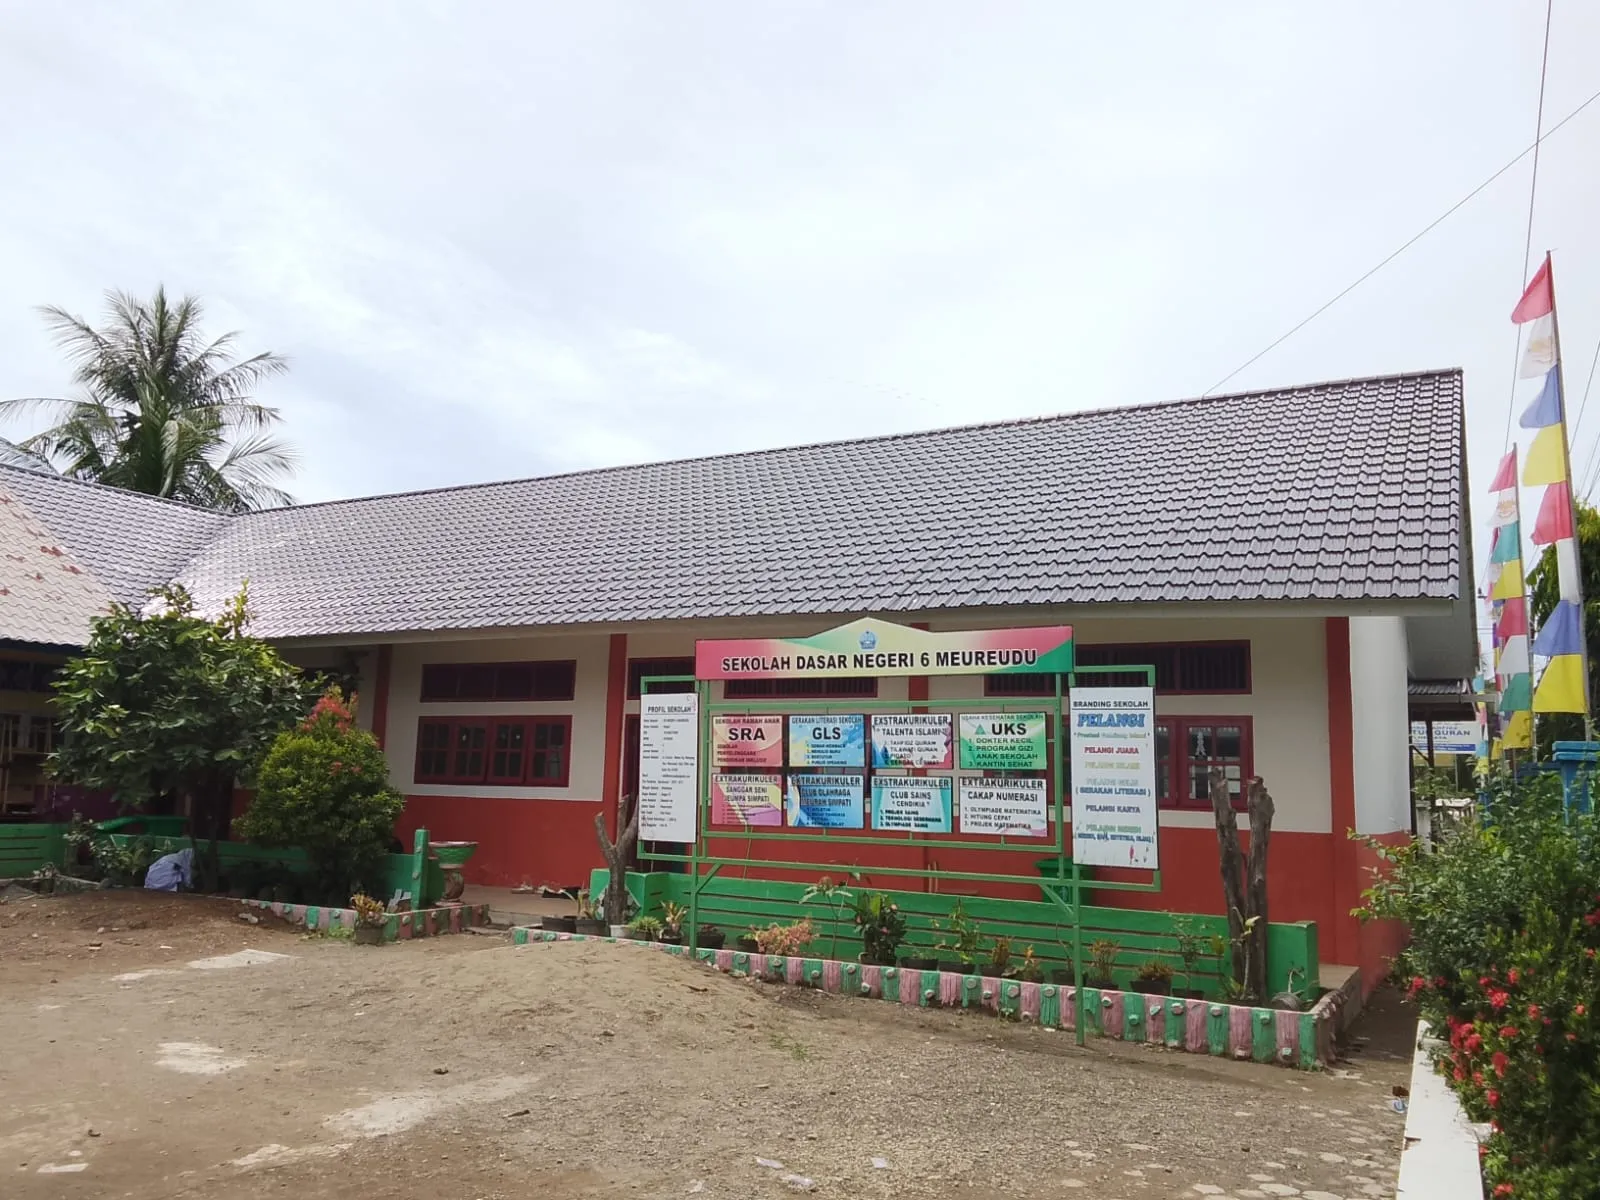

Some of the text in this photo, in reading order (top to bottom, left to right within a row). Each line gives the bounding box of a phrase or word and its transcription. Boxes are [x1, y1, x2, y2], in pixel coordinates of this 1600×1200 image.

[722, 649, 1036, 671] SEKOLAH DASAR NEGERI 6 MEUREUDU
[838, 716, 862, 724] SEKOLAH
[1077, 713, 1146, 728] PELANGI
[728, 728, 766, 740] SRA
[812, 726, 841, 740] GLS
[882, 728, 914, 736] TALENTA
[992, 722, 1027, 736] UKS
[1084, 746, 1140, 754] PELANGI JUARA
[791, 776, 860, 785] EXTRAKURIKULER
[874, 778, 949, 786] EXSTRAKURIKULER
[962, 778, 1043, 788] EXTRAKURIKULER
[890, 790, 932, 800] CLUB SAINS
[968, 791, 1038, 802] CAKAP NUMERASI
[970, 806, 1002, 814] OLYMPIADE
[1086, 804, 1116, 812] PELANGI
